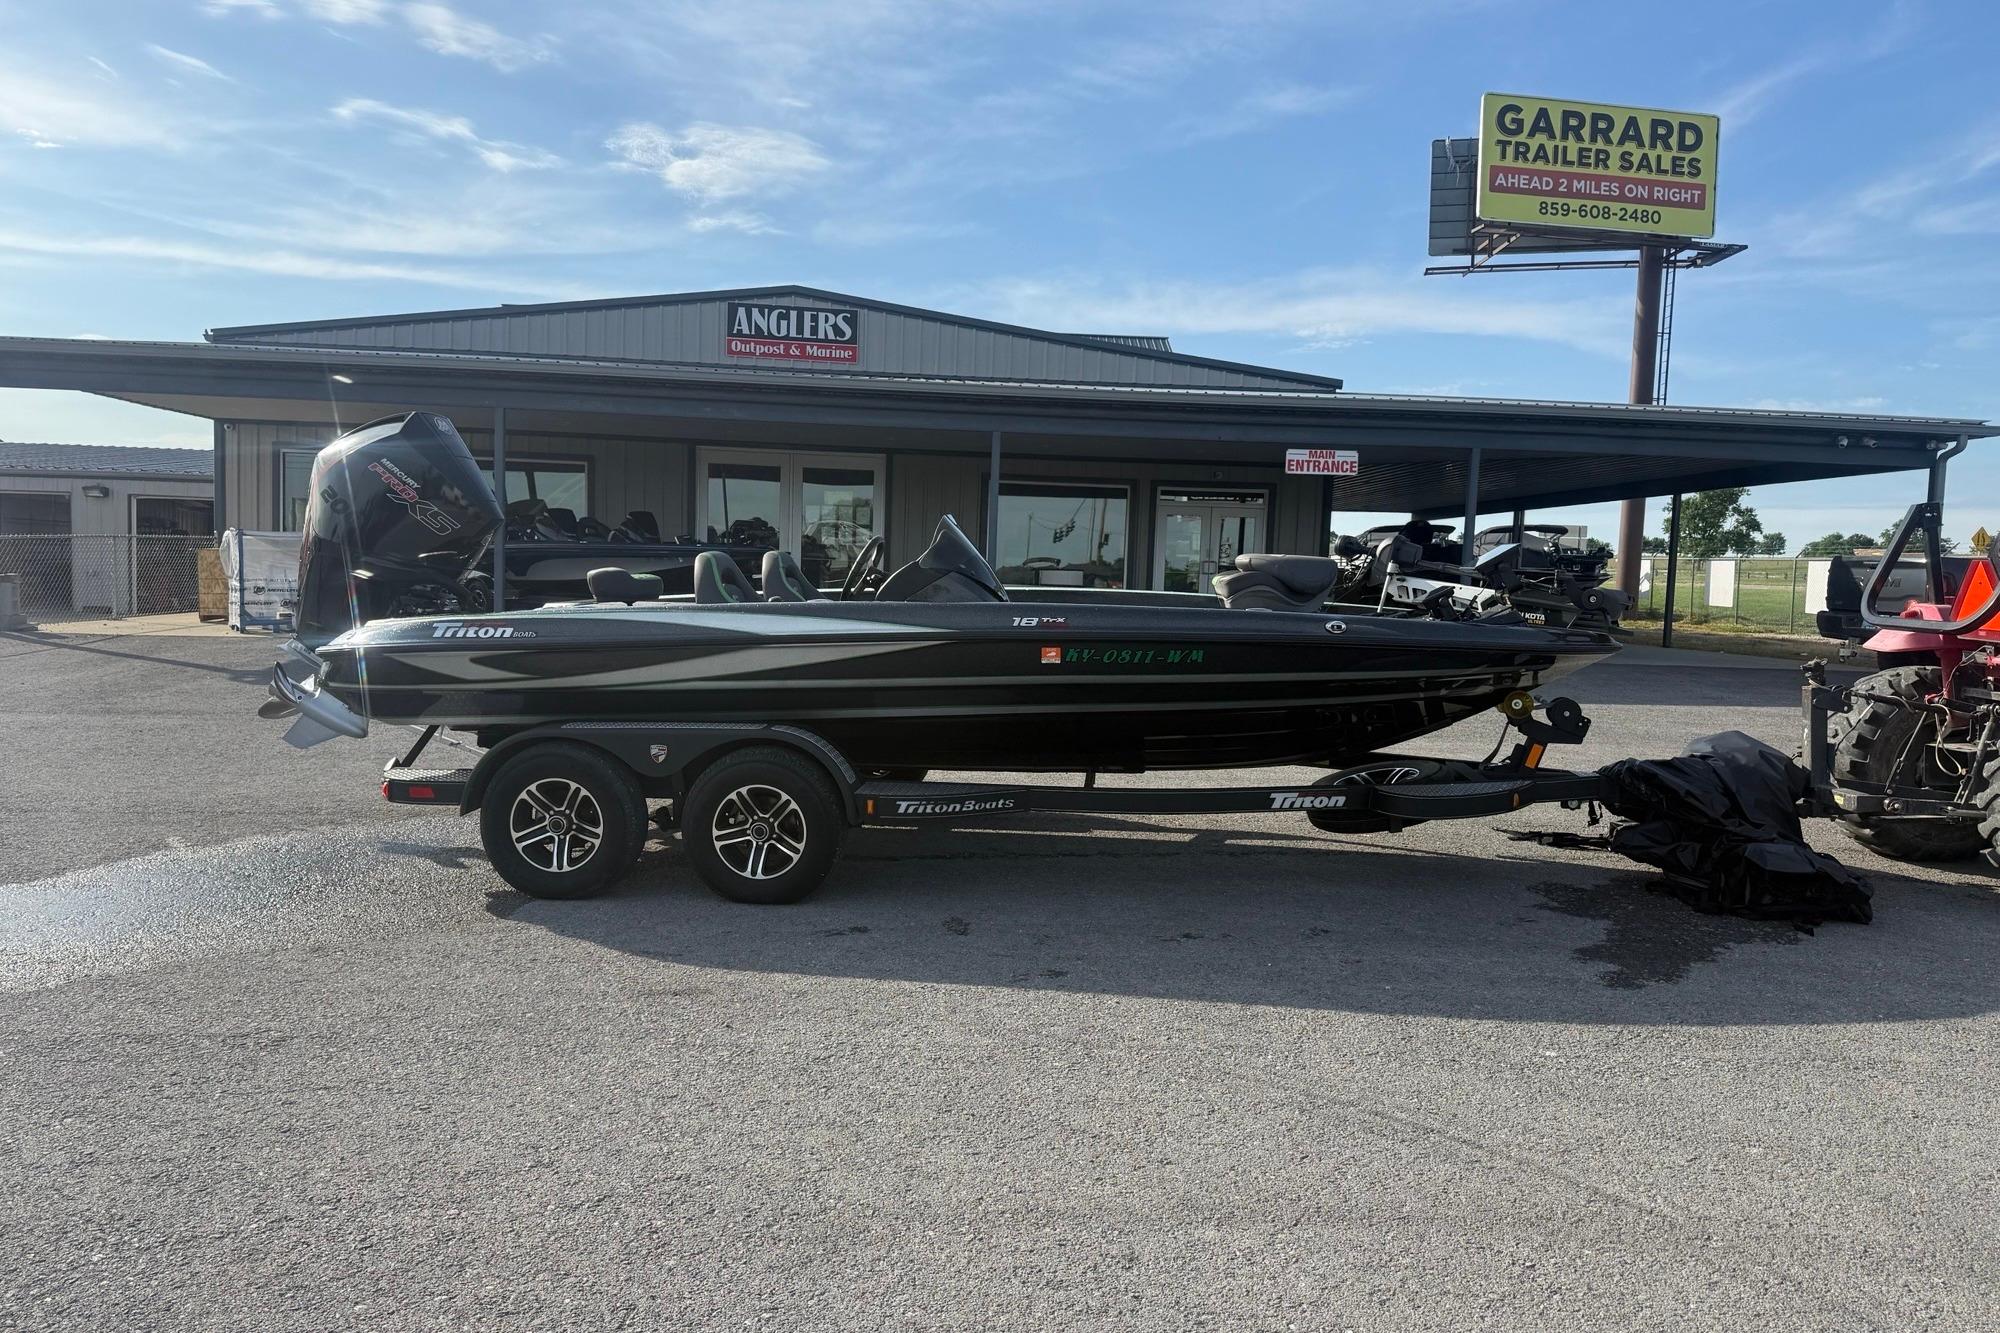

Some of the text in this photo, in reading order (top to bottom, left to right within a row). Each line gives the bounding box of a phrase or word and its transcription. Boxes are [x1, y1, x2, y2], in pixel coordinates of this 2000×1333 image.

[1495, 103, 1704, 153] GARRARD
[1495, 139, 1703, 179] TRAILER SALES
[1494, 172, 1702, 204] AHEAD 2 MILES ON RIGHT
[1538, 201, 1662, 225] 859-608-2480
[732, 306, 853, 341] ANGLERS
[731, 340, 853, 359] Outpost & Marine
[1308, 450, 1336, 460] MAIN
[380, 458, 421, 489] MERCURY
[1287, 459, 1357, 473] ENTRANCE
[368, 462, 461, 535] PRO XS
[1012, 617, 1039, 627] 18
[1524, 612, 1546, 621] KOTA
[432, 622, 514, 638] Triton
[1065, 648, 1205, 664] KY-0811-WM
[1269, 792, 1347, 809] Triton
